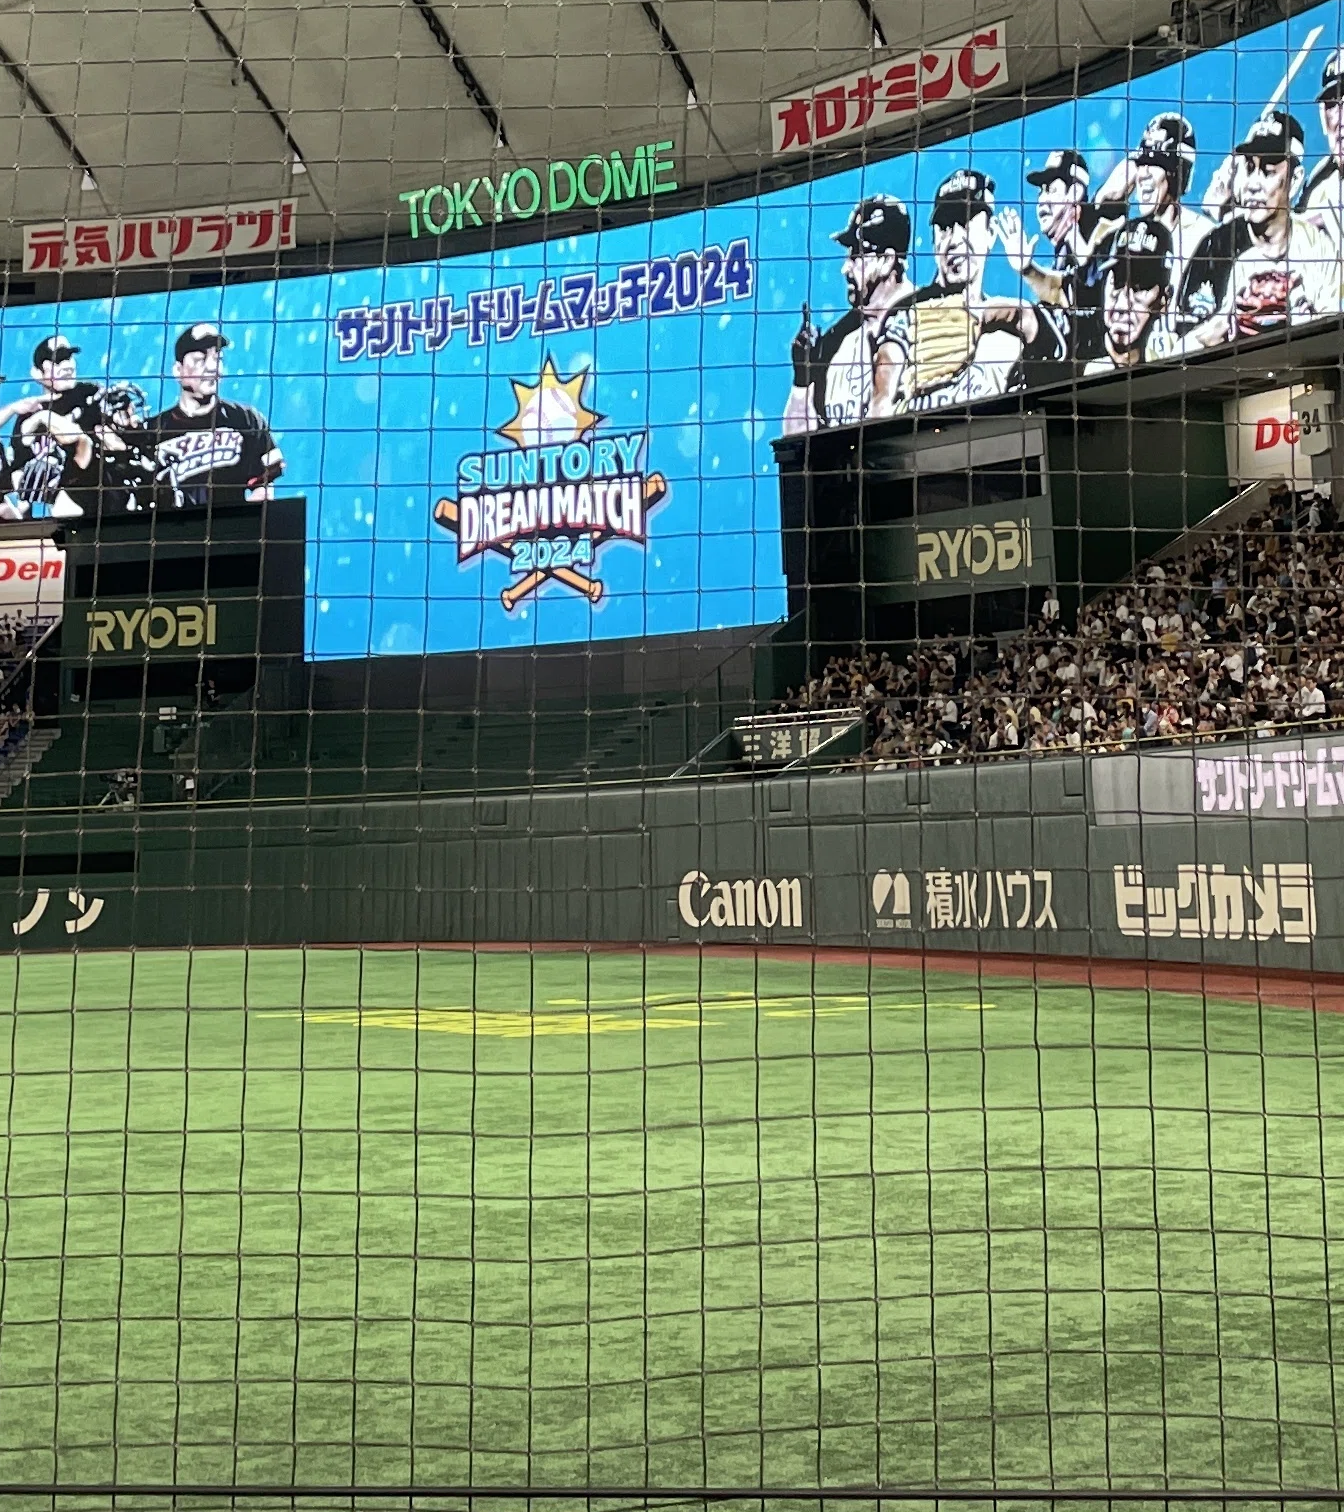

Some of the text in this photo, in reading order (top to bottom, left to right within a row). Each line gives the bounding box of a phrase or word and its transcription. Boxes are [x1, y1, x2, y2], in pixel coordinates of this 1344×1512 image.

[778, 29, 1001, 151] オロナミンC
[399, 140, 678, 239] TOKYO DOME
[336, 237, 755, 362] サントリードリームマッチ2024
[1301, 408, 1321, 435] 34
[459, 432, 646, 494] SUNTORY
[511, 533, 594, 573] 2024
[917, 517, 1033, 582] RYOBI
[86, 604, 217, 653] RYOBI
[678, 870, 803, 928] Canon
[925, 867, 1058, 929] 積水ハウス
[1113, 863, 1317, 943] ビックカメラ
